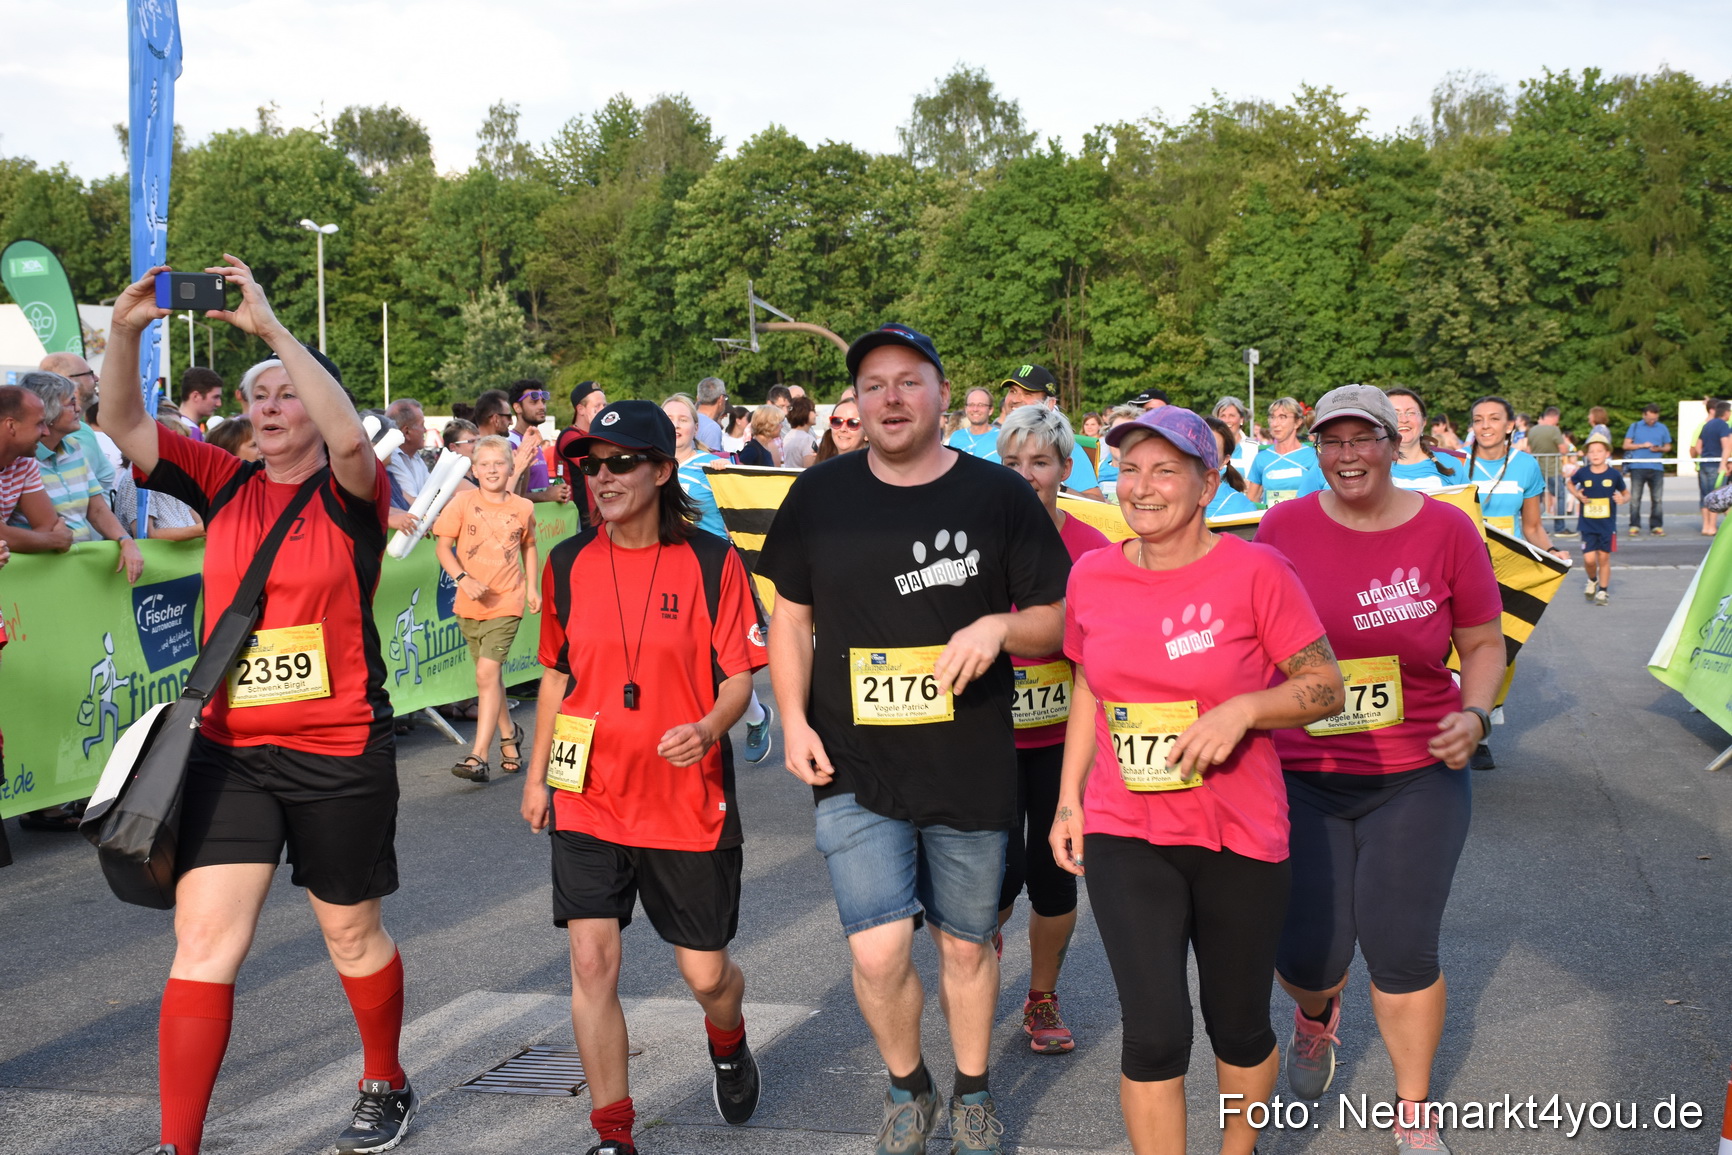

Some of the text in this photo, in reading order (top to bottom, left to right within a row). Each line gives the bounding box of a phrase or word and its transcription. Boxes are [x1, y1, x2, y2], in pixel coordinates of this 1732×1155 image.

[896, 558, 976, 593] PATRICK
[660, 593, 679, 613] 11
[1358, 578, 1418, 605] TANTE
[146, 603, 187, 626] Fischer
[151, 618, 182, 634] AUTOMOBILE
[1354, 600, 1436, 629] MARTINA
[1166, 631, 1214, 659] CARO
[236, 652, 312, 685] 2359
[427, 649, 466, 677] neumarkt
[247, 680, 306, 693] Schwenk Birgit
[863, 675, 938, 703] 2176
[1011, 683, 1066, 711] 2174
[1343, 683, 1389, 713] 75
[902, 703, 930, 711] Patrick
[1352, 711, 1382, 720] Martina
